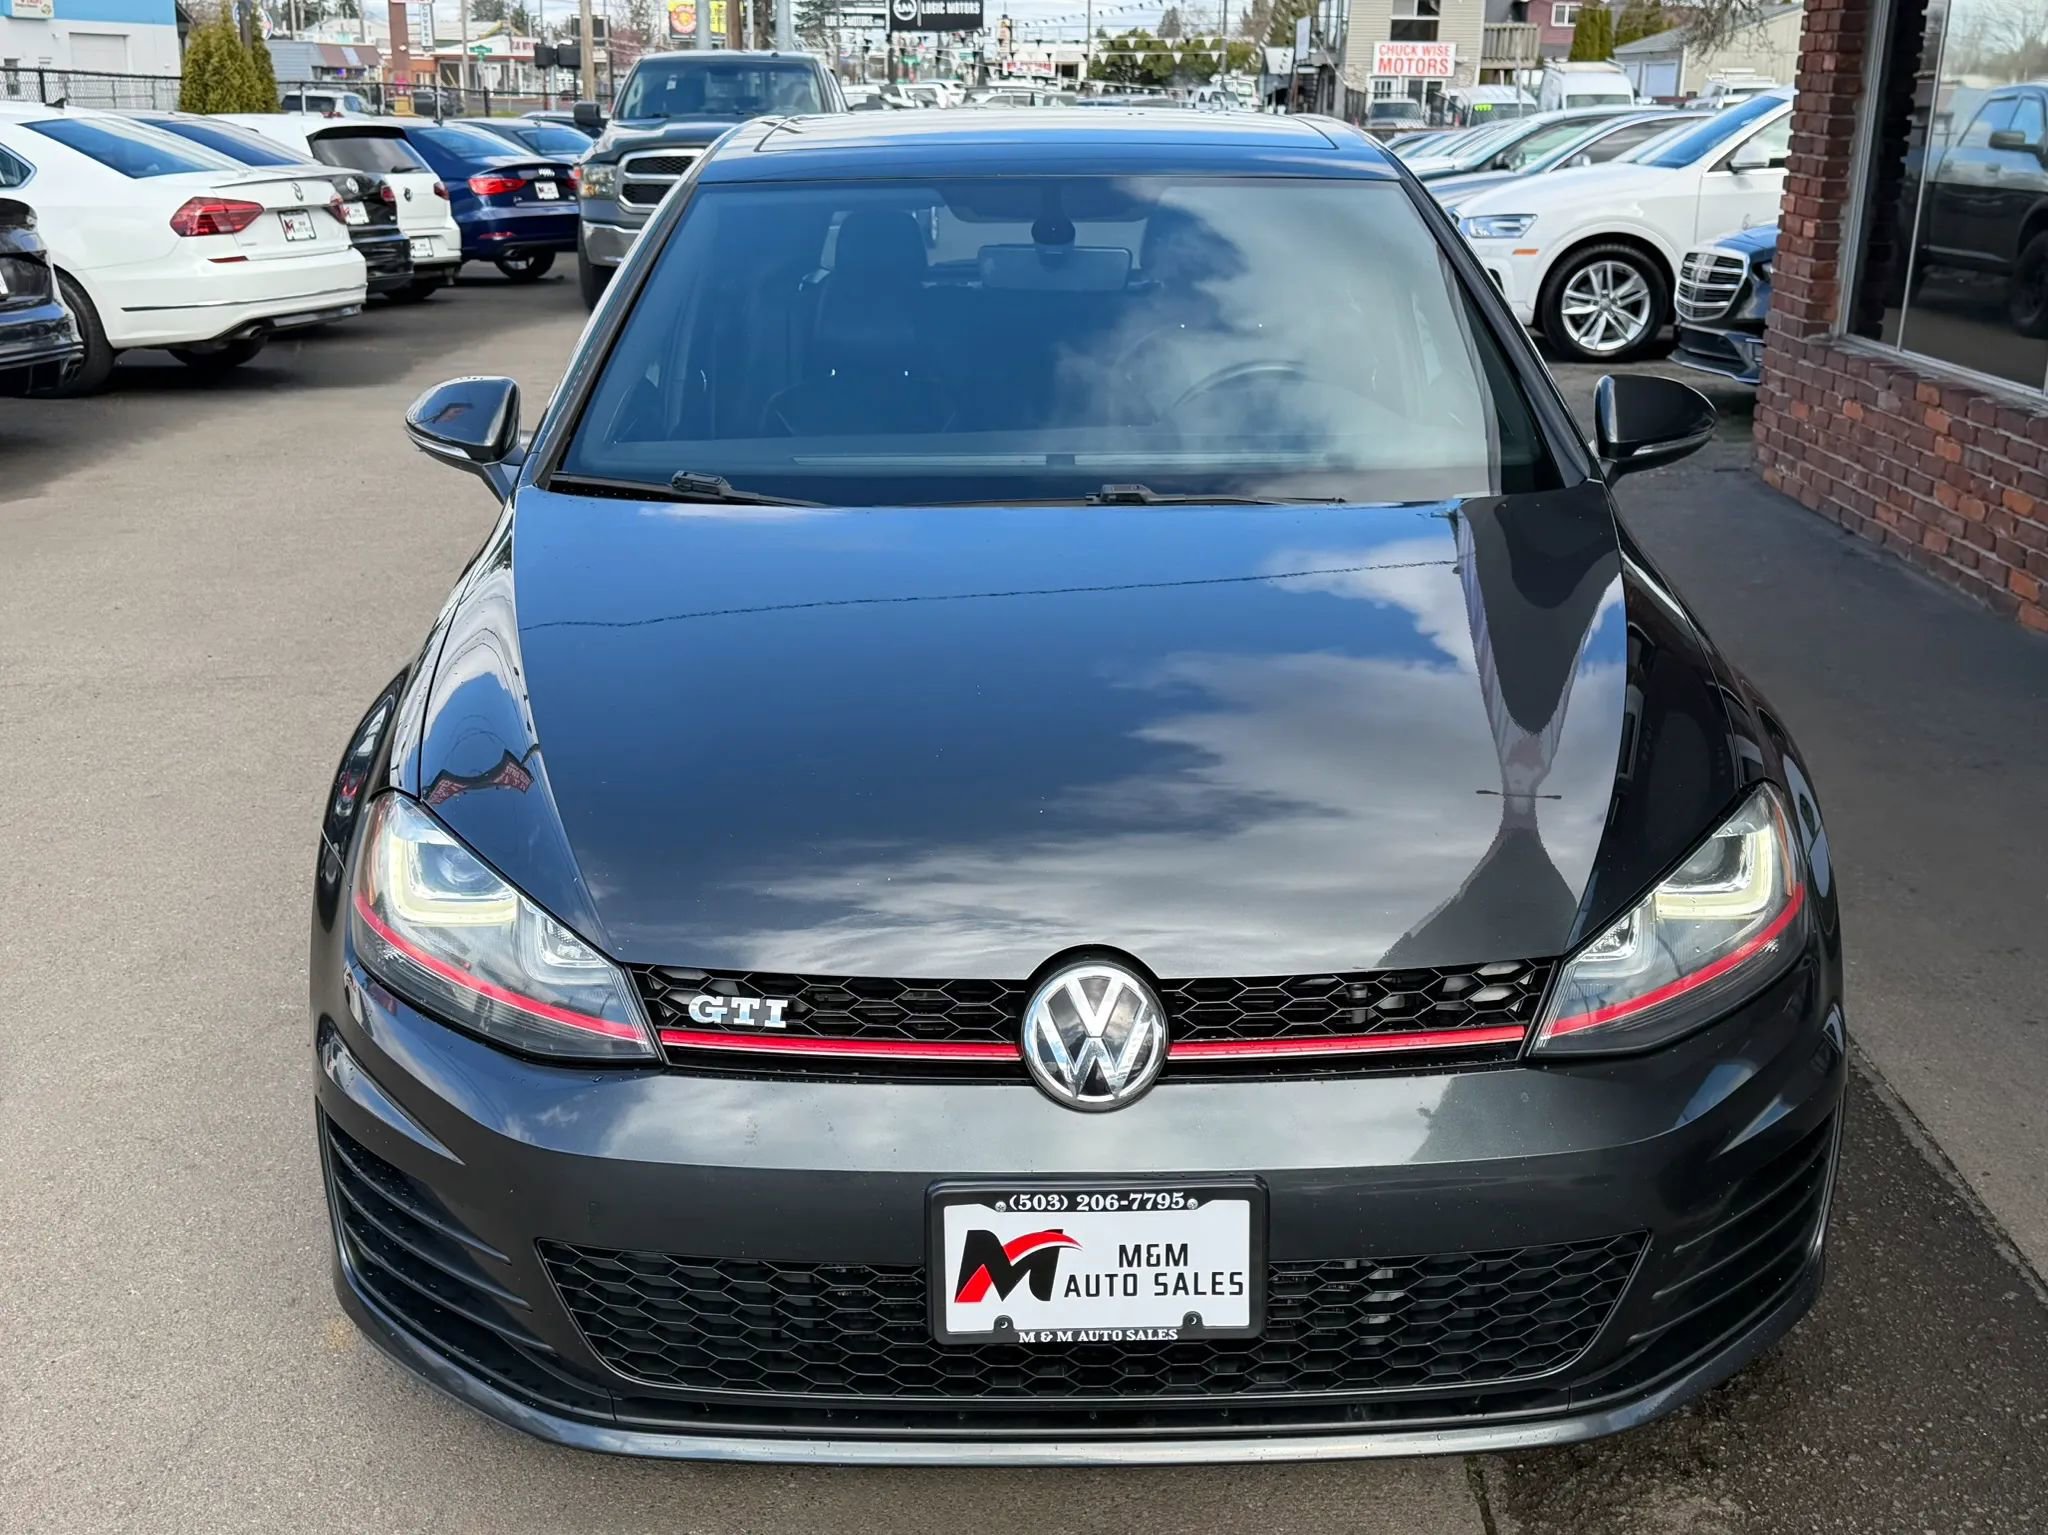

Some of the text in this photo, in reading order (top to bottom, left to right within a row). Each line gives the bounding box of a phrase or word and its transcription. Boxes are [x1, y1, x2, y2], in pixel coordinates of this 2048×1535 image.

[921, 2, 980, 14] LOGIC MOTORS
[1379, 44, 1450, 57] CHUCK WISE
[1378, 58, 1449, 75] MOTORS
[688, 994, 788, 1028] GTI
[1009, 1192, 1185, 1212] (503) 206-7795
[1118, 1243, 1188, 1268] M&M
[1064, 1271, 1244, 1298] AUTO SALES
[1018, 1329, 1178, 1344] M & M AUTO SALES
